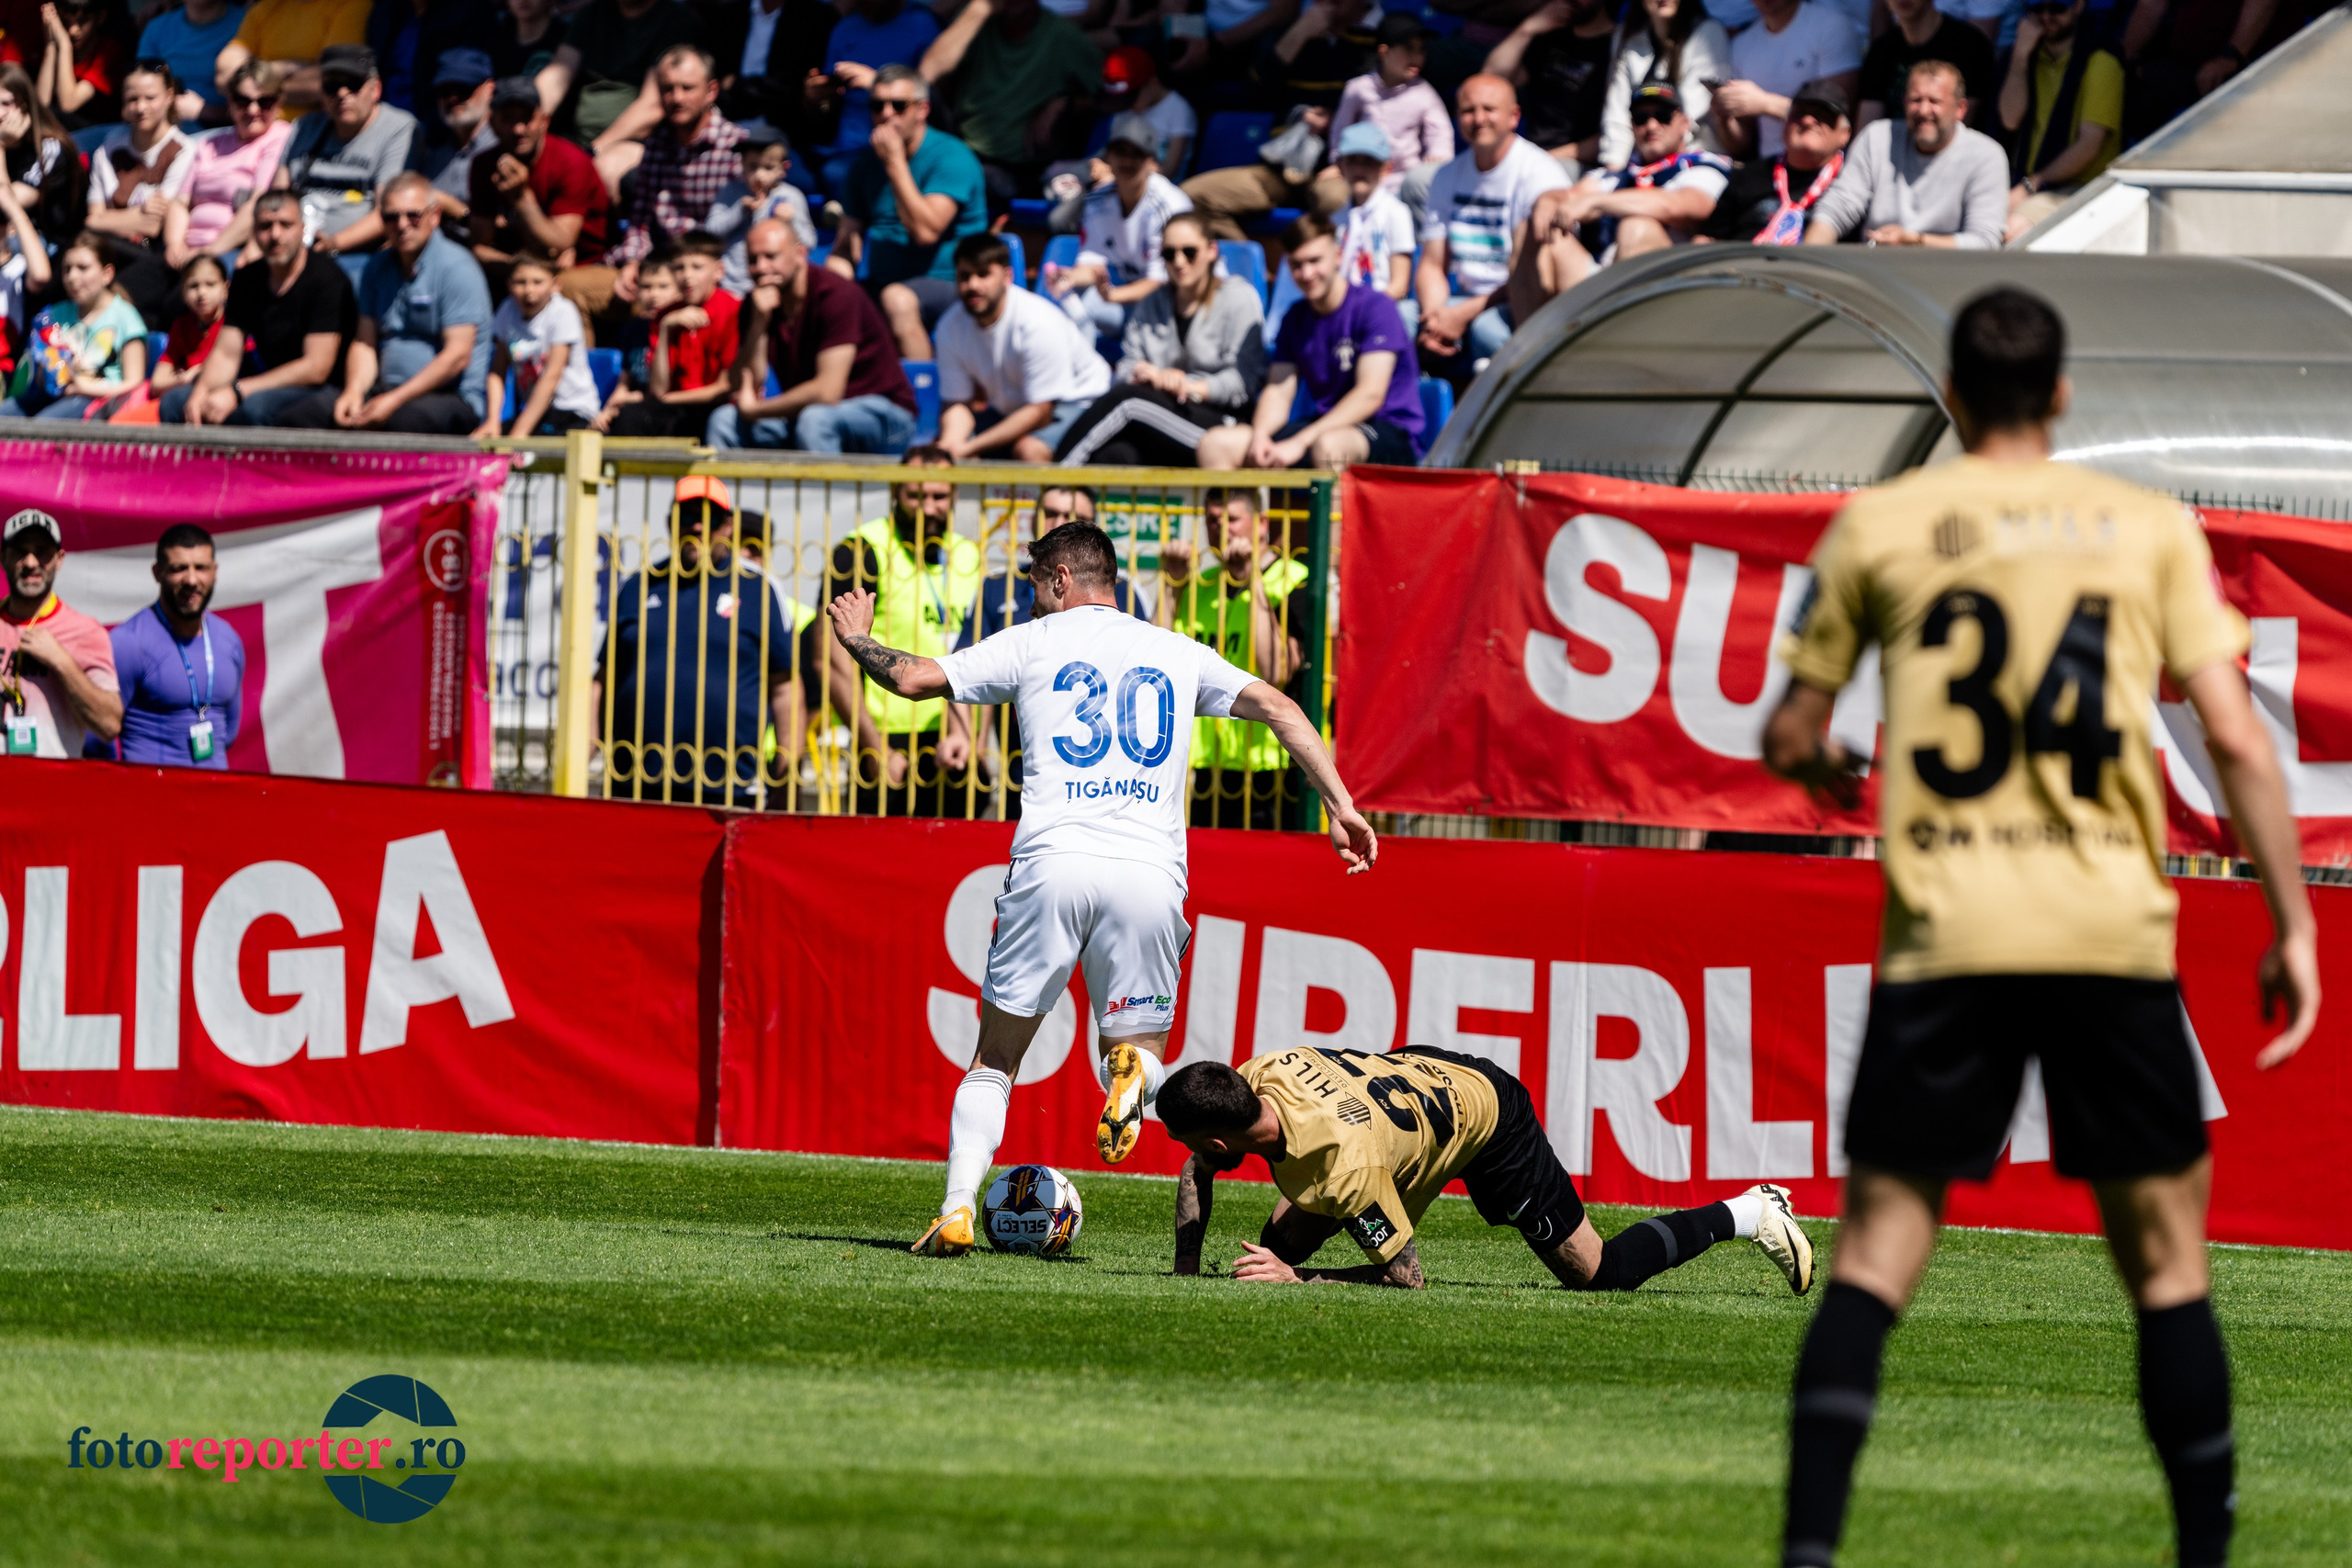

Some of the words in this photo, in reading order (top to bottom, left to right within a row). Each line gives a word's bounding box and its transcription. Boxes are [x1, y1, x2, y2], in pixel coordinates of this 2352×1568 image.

[1052, 660, 1175, 768] 30
[1912, 587, 2122, 799] 34
[0, 829, 515, 1071] LIGA
[1126, 995, 1155, 1006] Smart
[1155, 995, 1172, 1005] Eco
[1279, 1051, 1339, 1099] HILS
[1301, 1051, 1351, 1089] DEVELOPMEN
[1377, 1097, 1391, 1110] FCV
[996, 1218, 1047, 1234] SELECT
